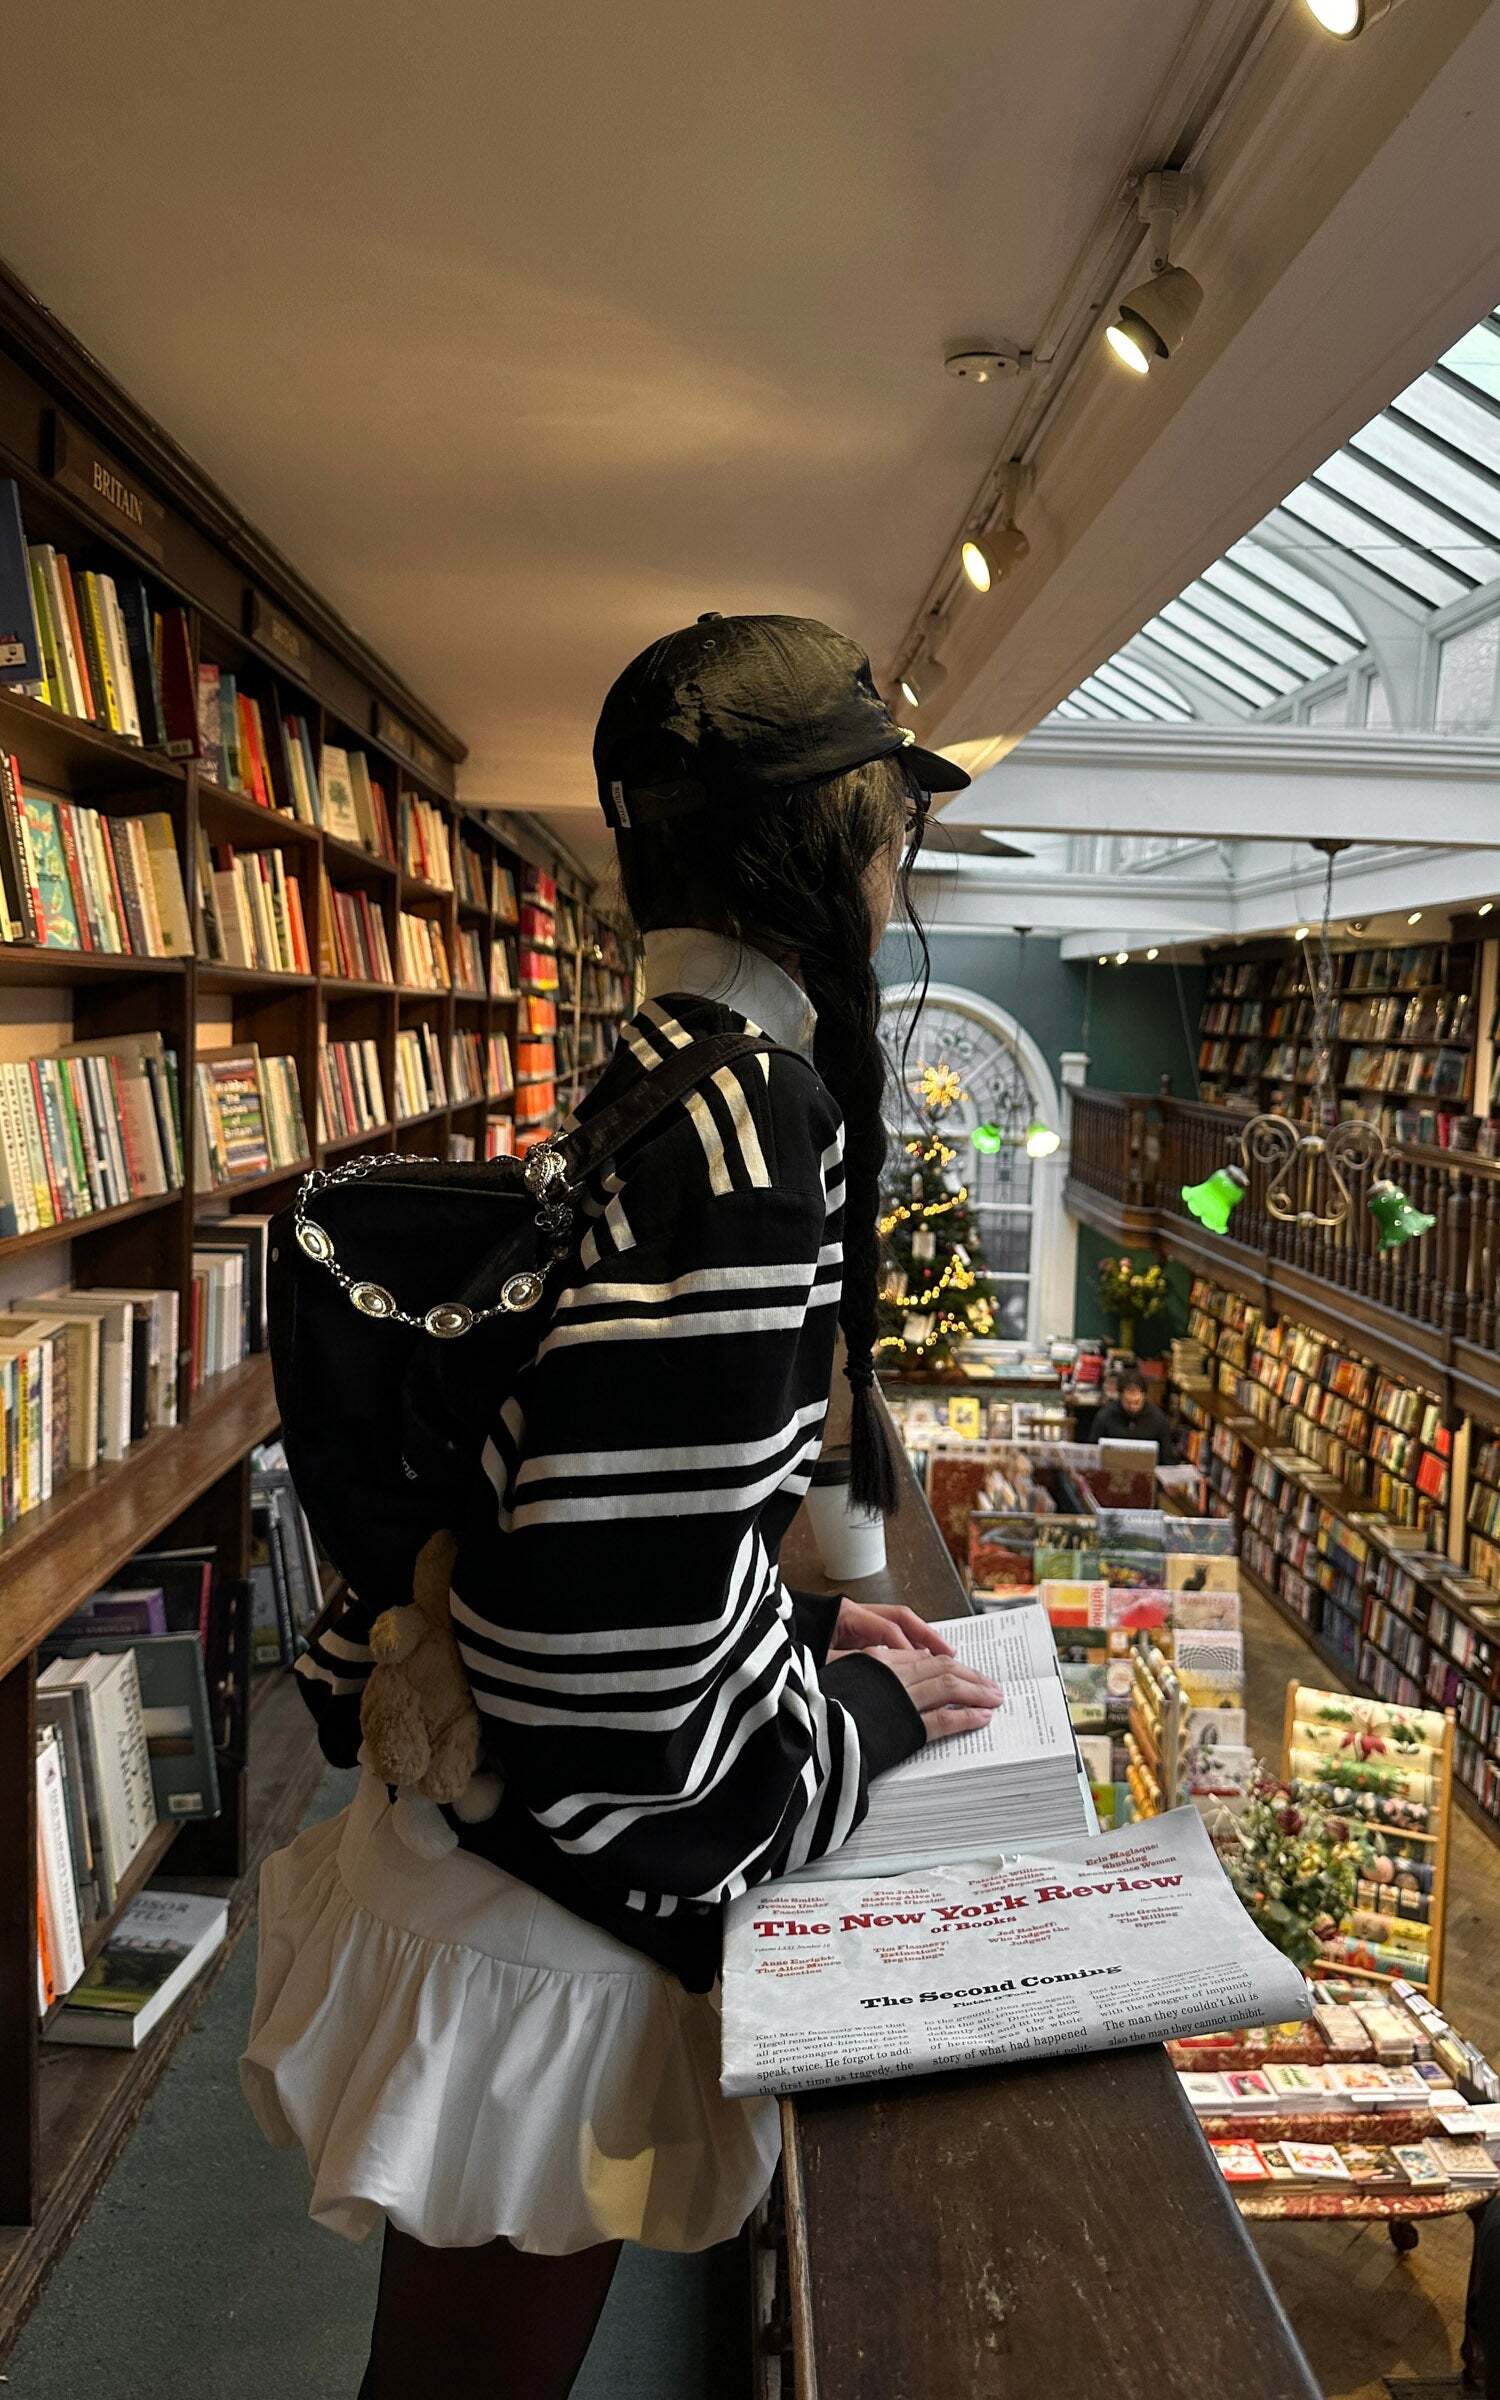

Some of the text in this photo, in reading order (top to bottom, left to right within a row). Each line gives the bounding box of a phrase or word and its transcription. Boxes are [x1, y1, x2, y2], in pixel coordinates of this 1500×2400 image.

[93, 461, 142, 527] BRITAIN
[1086, 1856, 1108, 1866] Erin
[1102, 1855, 1148, 1869] Shushing
[1140, 1856, 1176, 1869] Women
[753, 1920, 831, 1937] The
[839, 1912, 927, 1932] New
[931, 1894, 1030, 1921] York
[1034, 1874, 1183, 1904] Review
[930, 1915, 1017, 1934] of Books
[860, 1996, 913, 2009] The
[919, 1980, 1017, 2003] Second
[1020, 1965, 1123, 1987] Coming
[953, 1999, 992, 2008] Fintan
[1100, 2008, 1124, 2017] with
[1126, 2004, 1145, 2012] the
[1147, 1994, 1190, 2008] swagger
[1191, 1990, 1202, 1998] of
[1119, 1992, 1155, 2004] second
[1102, 1992, 1260, 2032] The man they couldn't kill is
[756, 2033, 777, 2041] Karl
[830, 2031, 885, 2041] somewhere
[930, 2042, 941, 2050] of
[1026, 2025, 1046, 2033] the
[1050, 2017, 1083, 2028] whole
[997, 2023, 1016, 2034] and
[1108, 2036, 1129, 2047] also
[1130, 2031, 1146, 2042] the
[1148, 2027, 1170, 2038] man
[1171, 2023, 1193, 2035] they
[1194, 2014, 1228, 2029] cannot
[756, 2049, 769, 2058] all
[772, 2046, 799, 2056] great
[932, 2053, 962, 2066] story
[964, 2048, 976, 2061] of
[979, 2044, 1007, 2058] what
[1010, 2038, 1031, 2052] had
[1033, 2026, 1088, 2047] happened
[756, 2057, 776, 2066] and
[779, 2050, 839, 2064] personages
[757, 2066, 791, 2081] speak,
[792, 2063, 824, 2074] twice.
[825, 2057, 841, 2068] He
[842, 2054, 874, 2065] forgot
[890, 2046, 912, 2057] add:
[759, 2061, 914, 2096] the first time as tragedy, the
